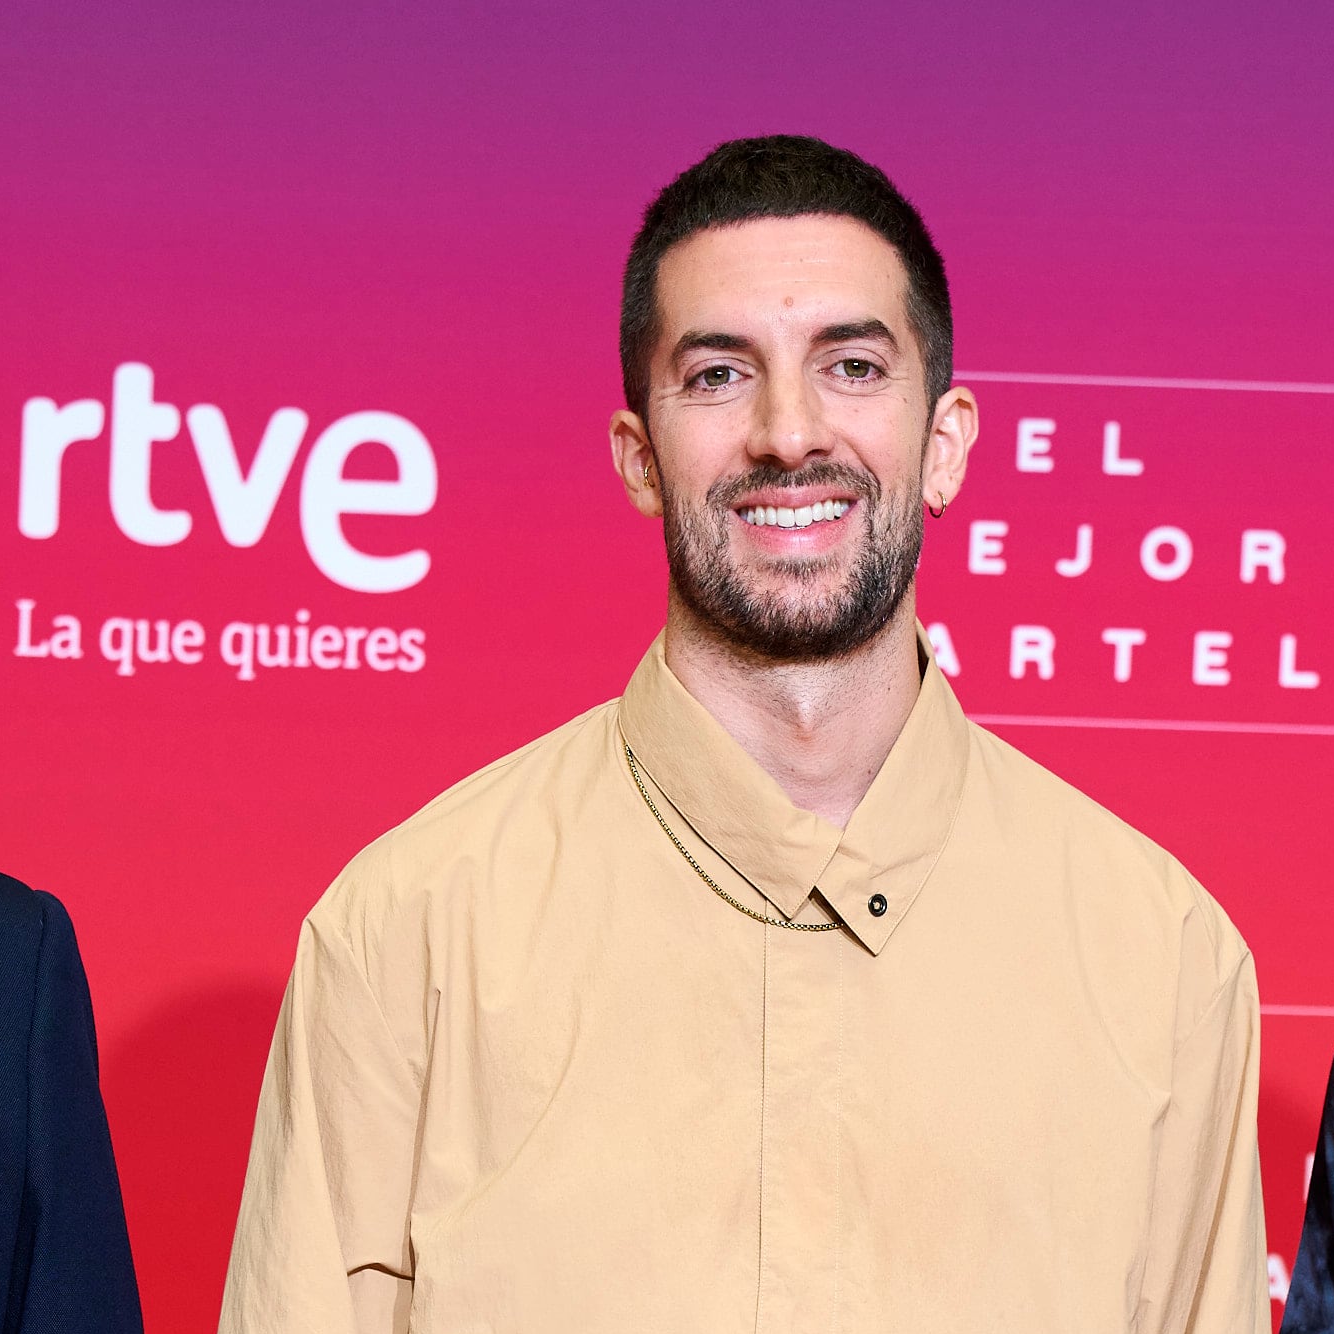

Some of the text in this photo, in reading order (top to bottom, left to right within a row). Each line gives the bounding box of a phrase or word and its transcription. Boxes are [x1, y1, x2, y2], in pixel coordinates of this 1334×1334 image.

[17, 361, 439, 594] rtve
[1015, 417, 1144, 477] EL
[967, 519, 1287, 585] EJOR
[14, 598, 427, 682] La que quieres
[926, 621, 1320, 691] ARTEL
